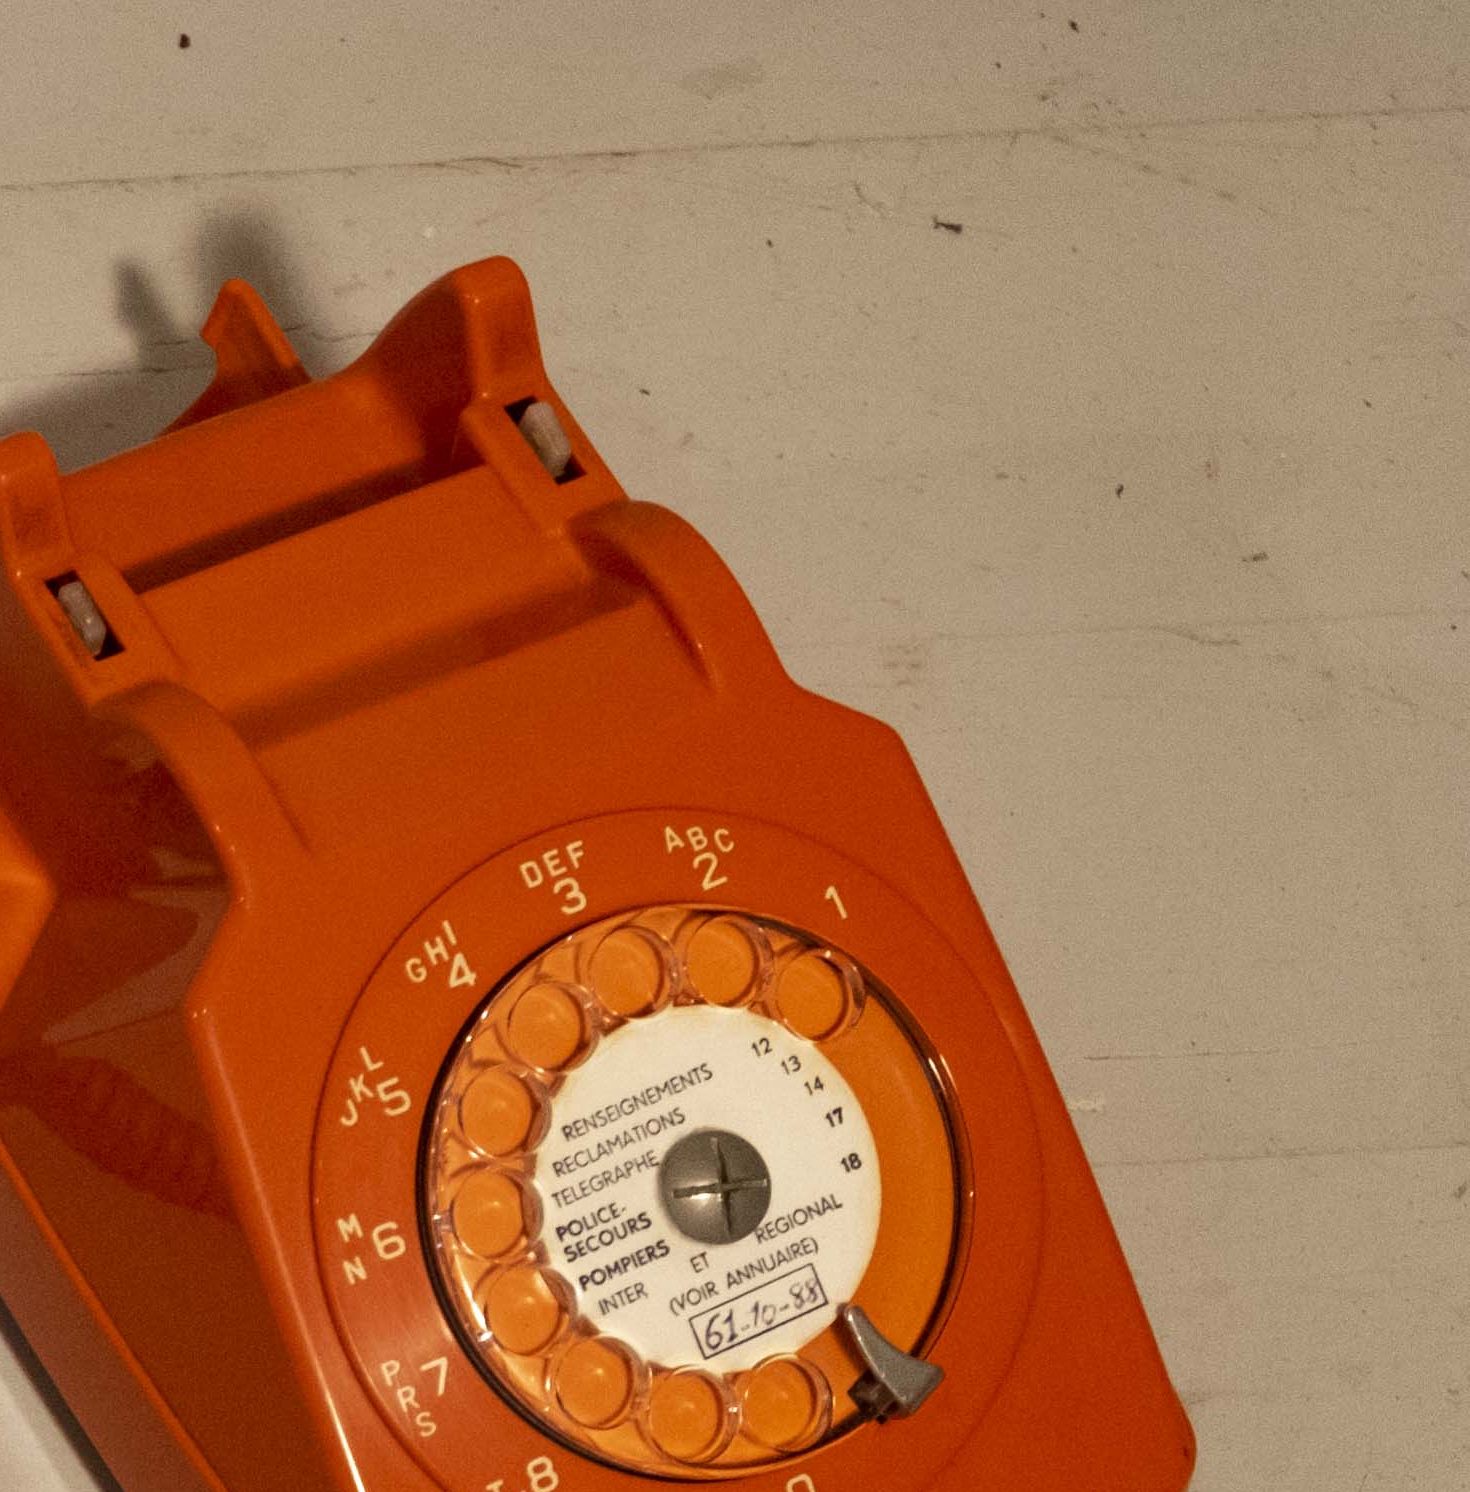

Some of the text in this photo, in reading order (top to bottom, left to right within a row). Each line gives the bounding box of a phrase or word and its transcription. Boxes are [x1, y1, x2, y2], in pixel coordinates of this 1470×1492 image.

[519, 840, 584, 888] DEF
[693, 852, 728, 891] 2
[553, 877, 587, 915] 3
[825, 885, 847, 919] 1
[448, 952, 477, 988] 4
[376, 1076, 412, 1116] 5
[561, 1037, 773, 1142] RENSEIGNEMENTS 12
[552, 1055, 803, 1178] RECLAMATIONS 13
[551, 1076, 825, 1210] TELEGRAPHE 14
[563, 1106, 845, 1264] SECOURS 17
[372, 1221, 406, 1260] 6
[555, 1202, 628, 1243] POLICE-
[578, 1152, 863, 1292] POMPIERS 18
[597, 1193, 843, 1316] INTER ET REGIONAL
[669, 1237, 819, 1317] (VOIR ANNUAIRE)
[420, 1356, 449, 1397] 7
